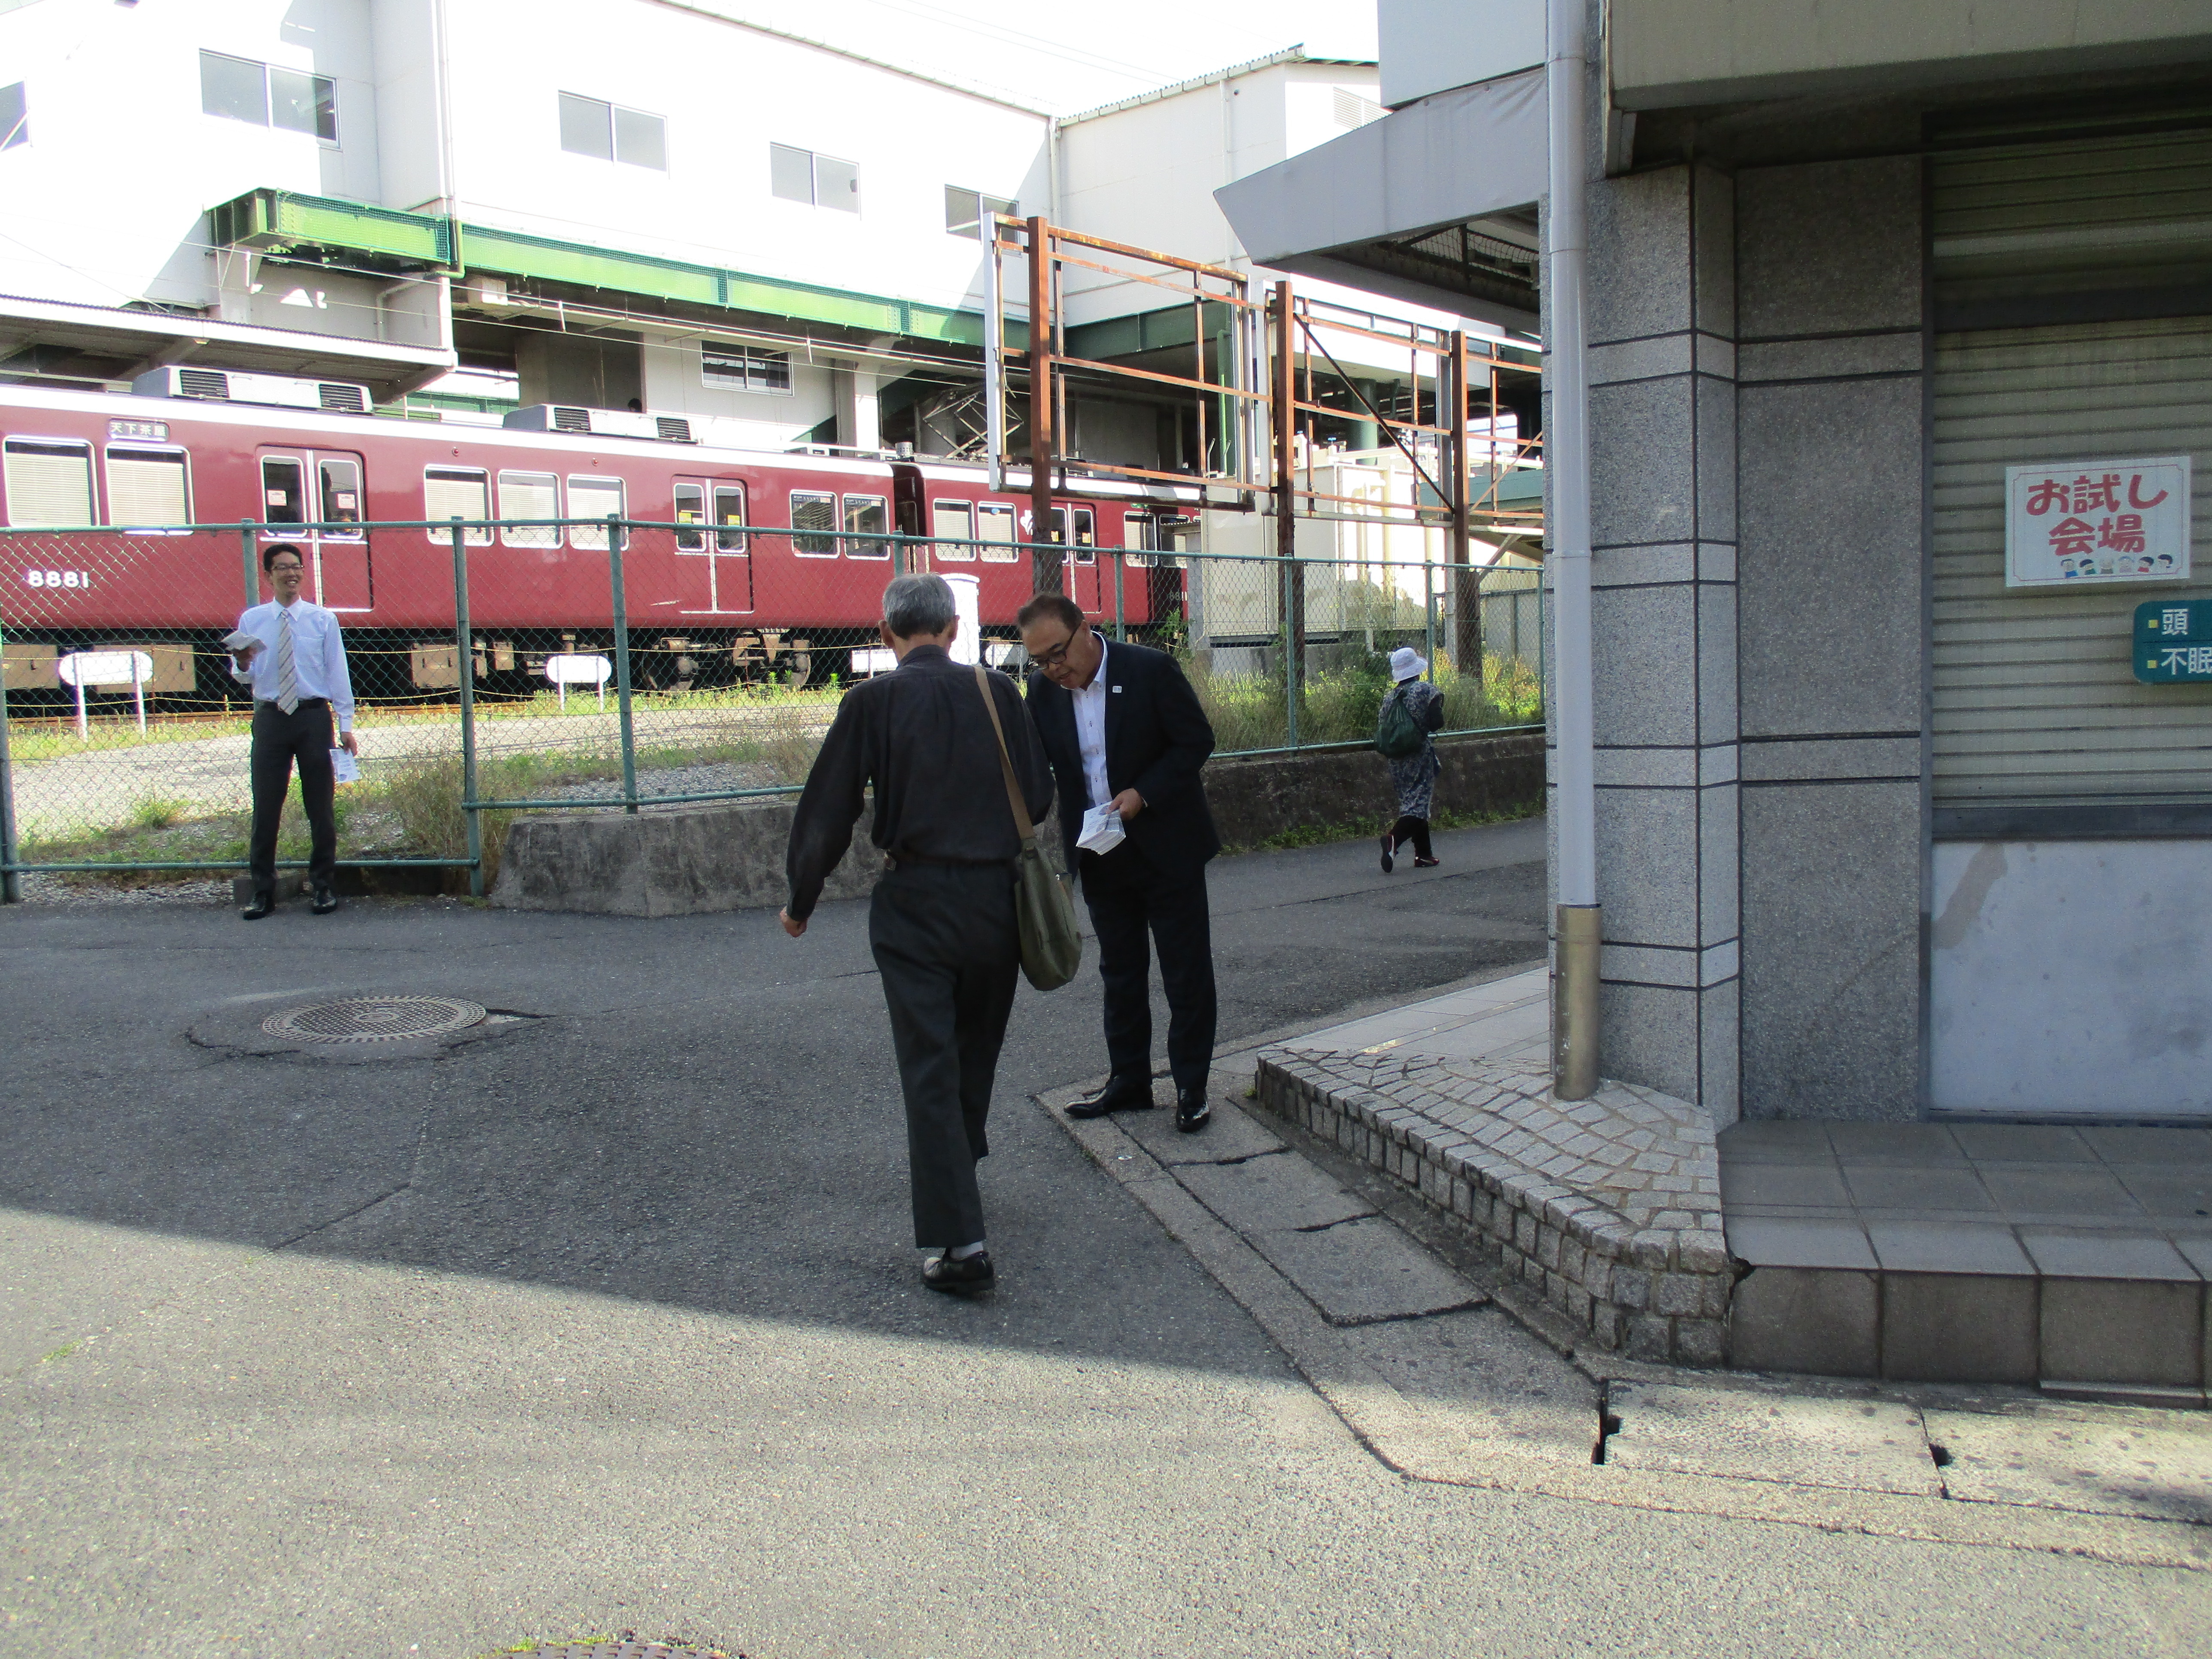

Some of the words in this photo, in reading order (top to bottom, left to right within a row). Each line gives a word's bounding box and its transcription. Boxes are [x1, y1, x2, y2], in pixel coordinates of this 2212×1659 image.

[110, 422, 166, 437] 天下茶屋
[2026, 474, 2169, 516] お試し
[2048, 514, 2145, 556] 会場
[28, 570, 89, 588] 8881
[2161, 608, 2189, 635] 頭
[2160, 647, 2212, 675] 不眠
